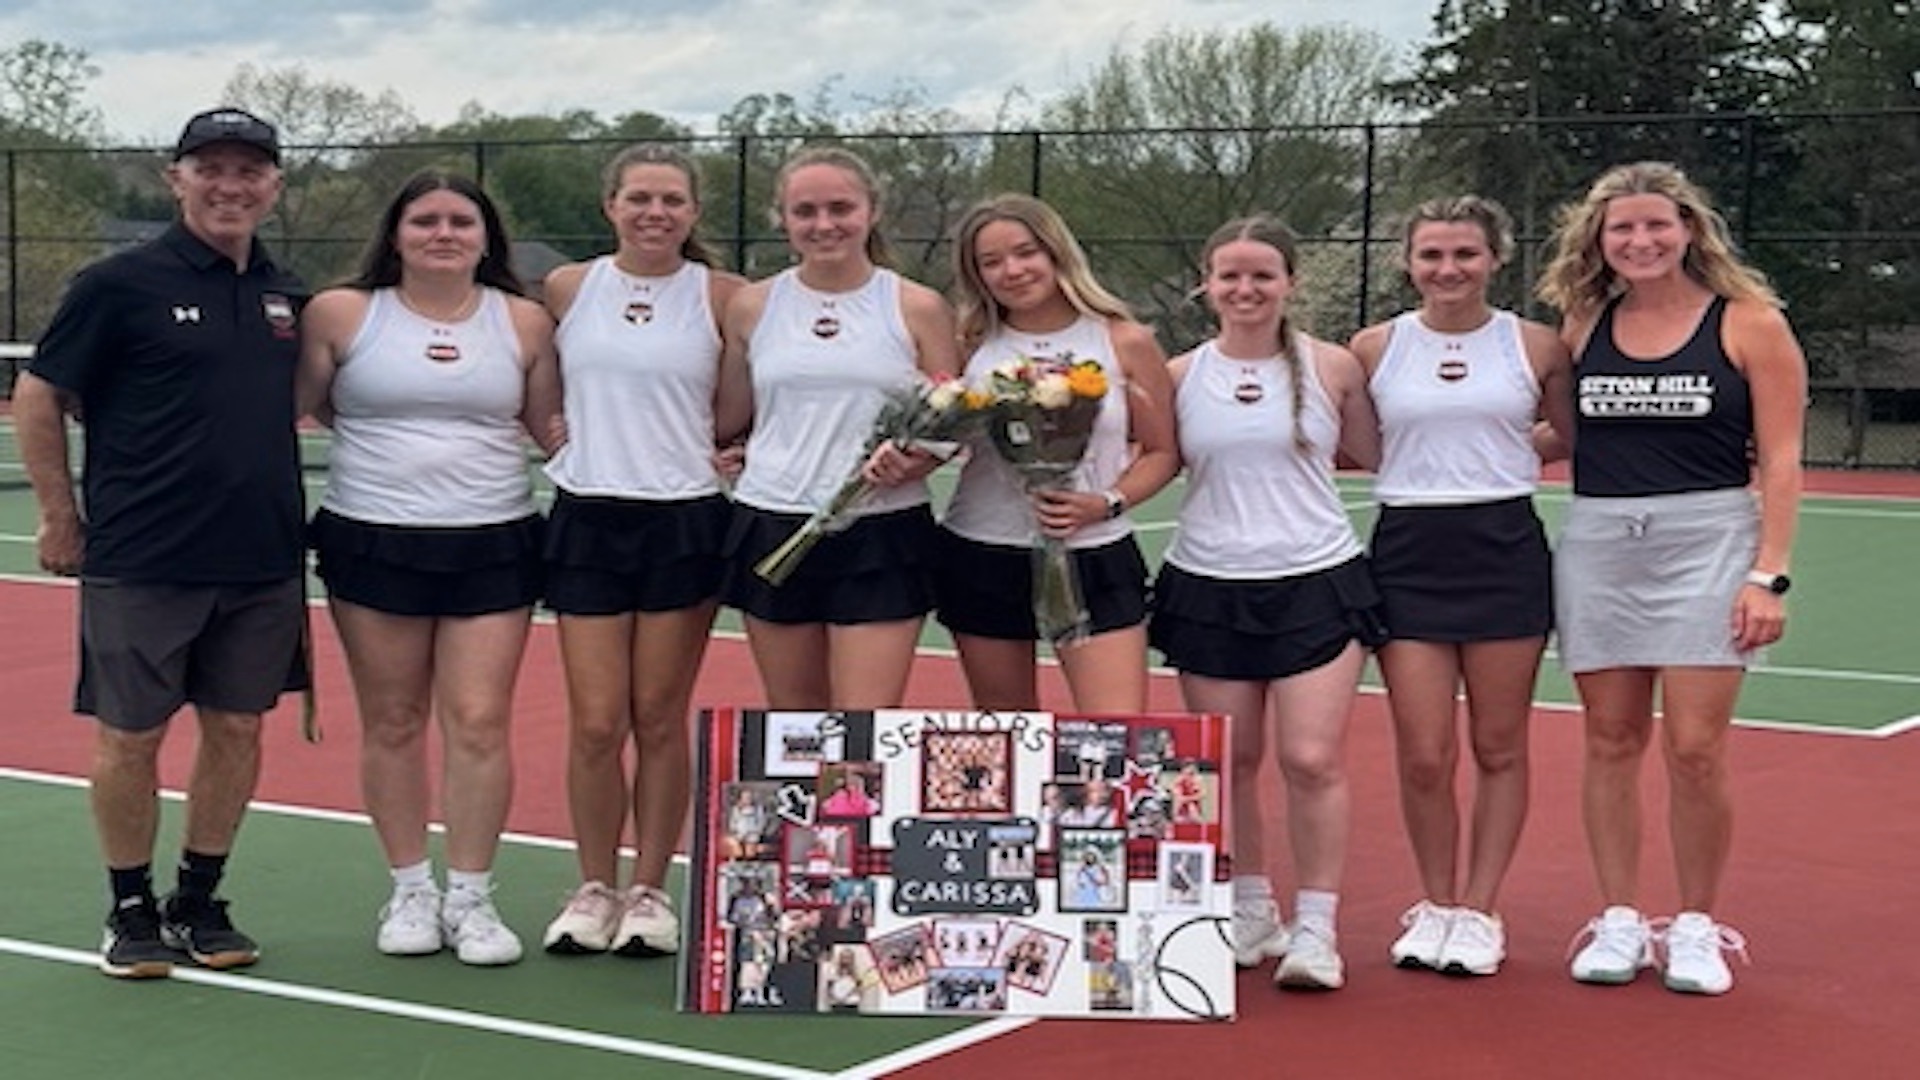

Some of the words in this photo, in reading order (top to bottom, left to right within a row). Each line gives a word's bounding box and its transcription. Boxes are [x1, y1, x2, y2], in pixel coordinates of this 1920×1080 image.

[1579, 375, 1655, 394] SETON
[1656, 375, 1714, 394] HILL
[879, 711, 1055, 758] SENIORS
[925, 828, 978, 849] ALY
[942, 850, 964, 873] &
[901, 880, 1030, 905] CARISSA
